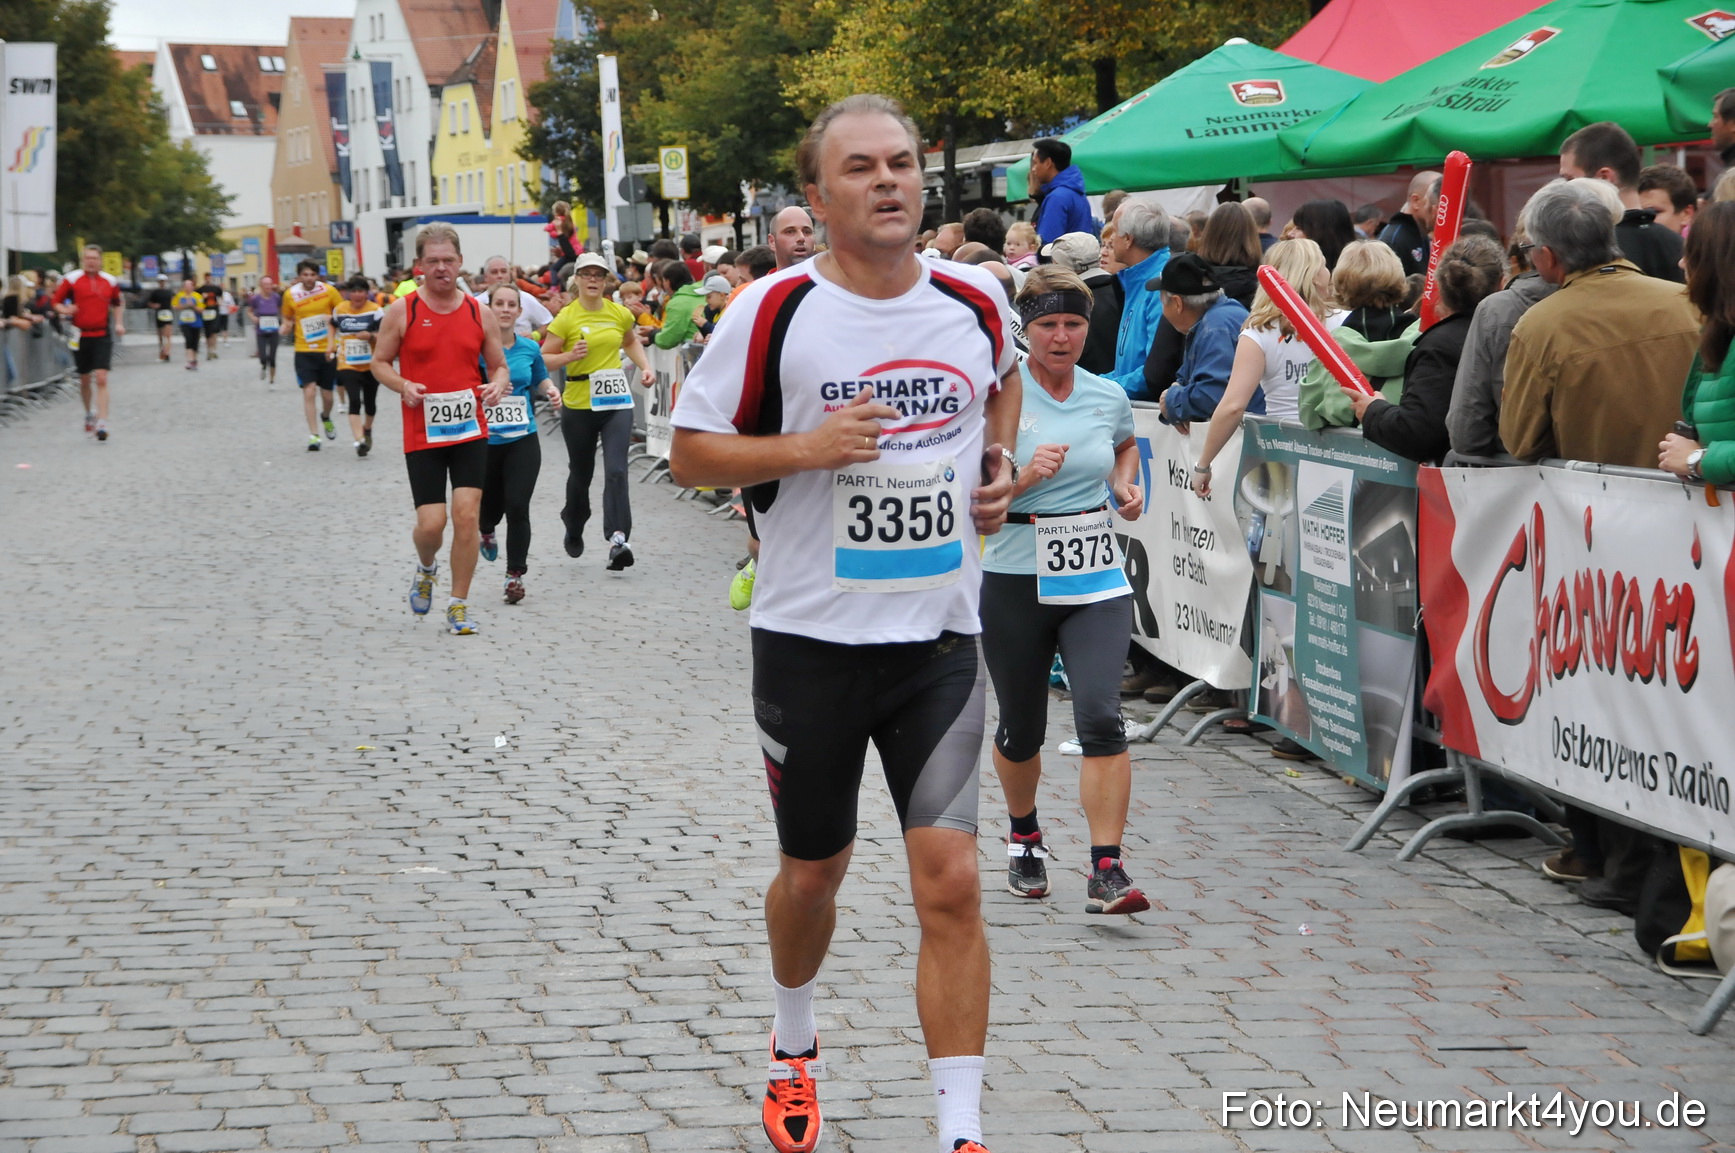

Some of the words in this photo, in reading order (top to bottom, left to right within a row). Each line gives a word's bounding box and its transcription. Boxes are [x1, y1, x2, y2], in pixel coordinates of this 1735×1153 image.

[1431, 239, 1441, 265] BKK
[594, 378, 627, 395] 2653
[820, 376, 945, 401] GERHART
[949, 382, 958, 392] &
[430, 401, 473, 423] 2942
[484, 406, 524, 424] 2833
[915, 425, 963, 450] Autohaus
[836, 473, 884, 489] PARTL
[847, 490, 955, 543] 3358
[1037, 525, 1071, 536] PARTL
[1072, 521, 1106, 533] Neumarkt
[1320, 523, 1346, 546] HOFFER
[1047, 533, 1114, 572] 3373
[1473, 501, 1702, 726] Charivari
[1315, 659, 1342, 681] Trockenbau
[1302, 672, 1357, 706] Fassadenverkleidungen
[1329, 718, 1361, 743] Sanierungen
[1664, 751, 1730, 815] Radio
